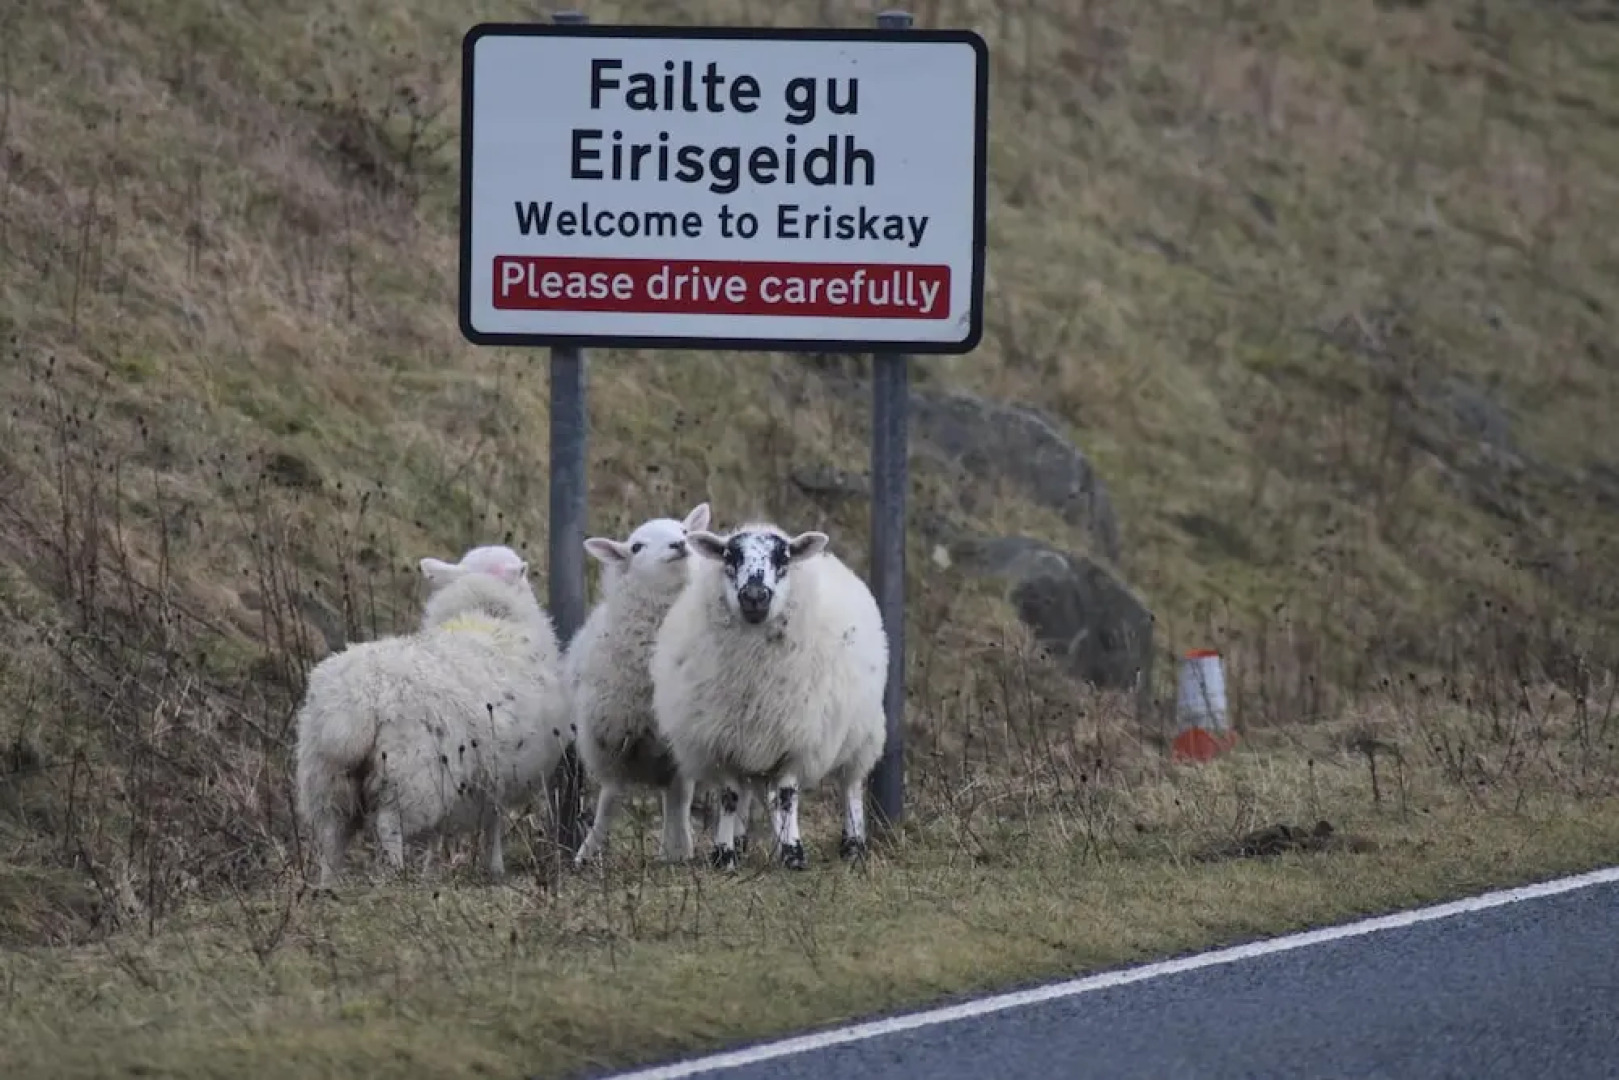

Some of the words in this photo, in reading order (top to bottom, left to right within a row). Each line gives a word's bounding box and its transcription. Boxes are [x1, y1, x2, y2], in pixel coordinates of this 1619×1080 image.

[590, 57, 762, 114] Failte
[784, 76, 859, 126] gu
[570, 128, 876, 195] Eirisgeidh
[514, 200, 704, 239] Welcome
[717, 203, 759, 240] to
[776, 203, 930, 249] Eriskay
[501, 261, 634, 299] Please
[647, 265, 748, 302] drive
[759, 270, 941, 313] carefully
